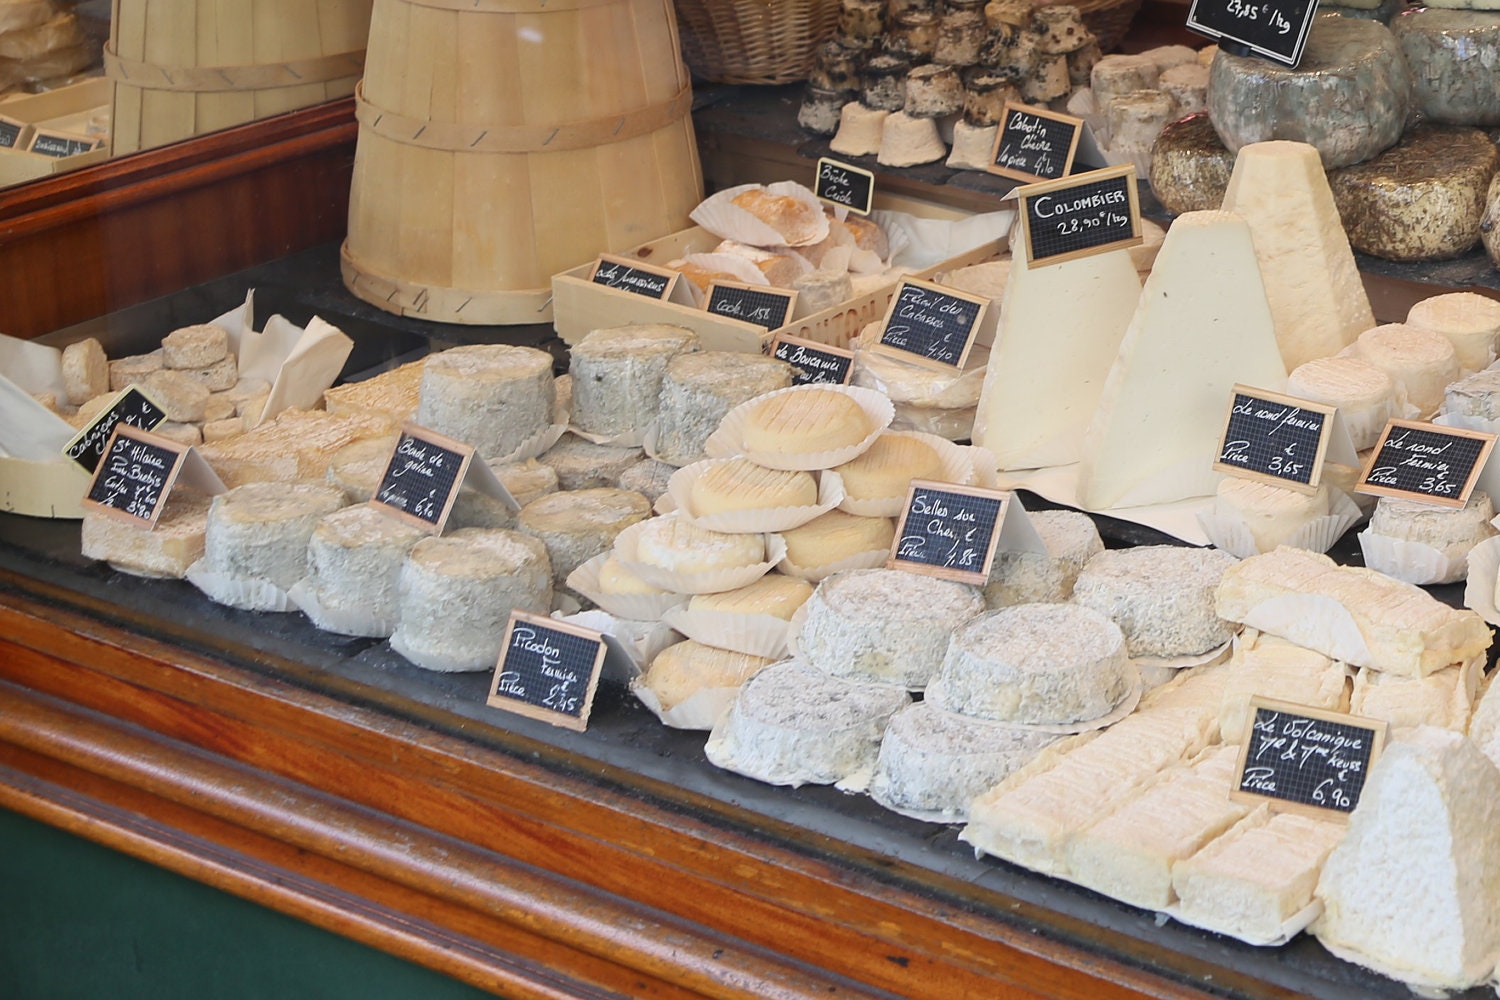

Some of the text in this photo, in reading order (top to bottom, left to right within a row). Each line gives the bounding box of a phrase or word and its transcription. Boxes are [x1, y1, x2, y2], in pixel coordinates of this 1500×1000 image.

[1008, 112, 1047, 137] Cabotin
[1035, 190, 1126, 218] COLOMBIER
[911, 495, 948, 517] Selles
[513, 627, 560, 658] Picodon
[1283, 719, 1362, 753] Volcanique
